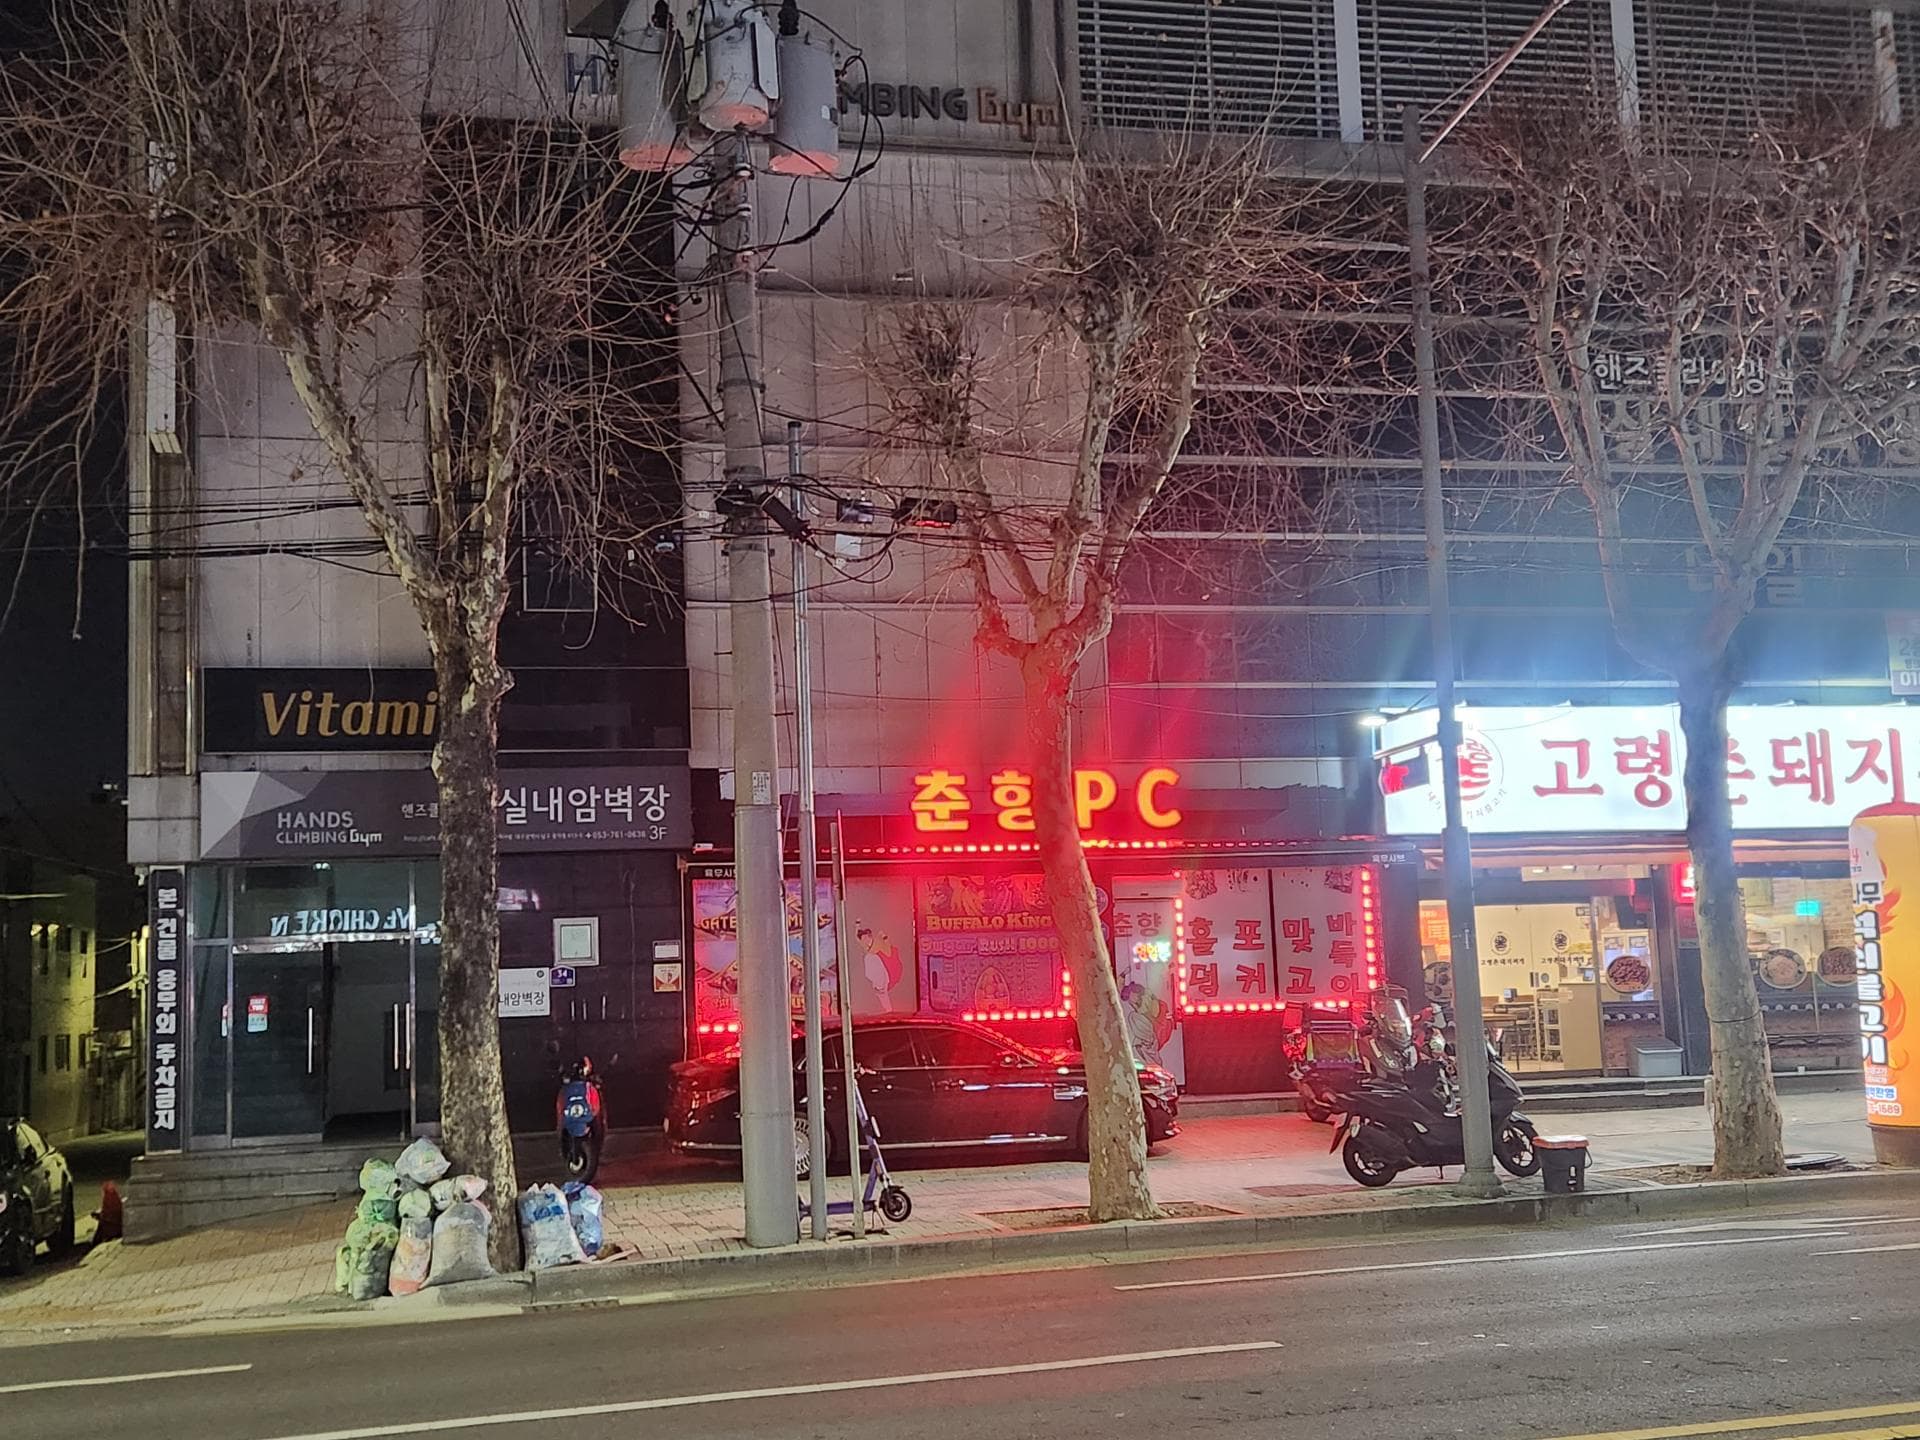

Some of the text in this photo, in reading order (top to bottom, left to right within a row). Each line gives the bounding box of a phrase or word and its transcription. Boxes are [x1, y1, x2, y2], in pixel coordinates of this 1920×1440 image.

[262, 690, 439, 737] Vitami
[498, 784, 671, 825] 실내암벽장
[277, 811, 354, 829] HANDS
[276, 831, 347, 845] CLIMBING
[648, 825, 668, 840] 3F
[158, 887, 177, 909] 본
[926, 913, 1006, 931] BUFFALO
[156, 917, 177, 961] 건물
[153, 1042, 177, 1131] 주차금지
